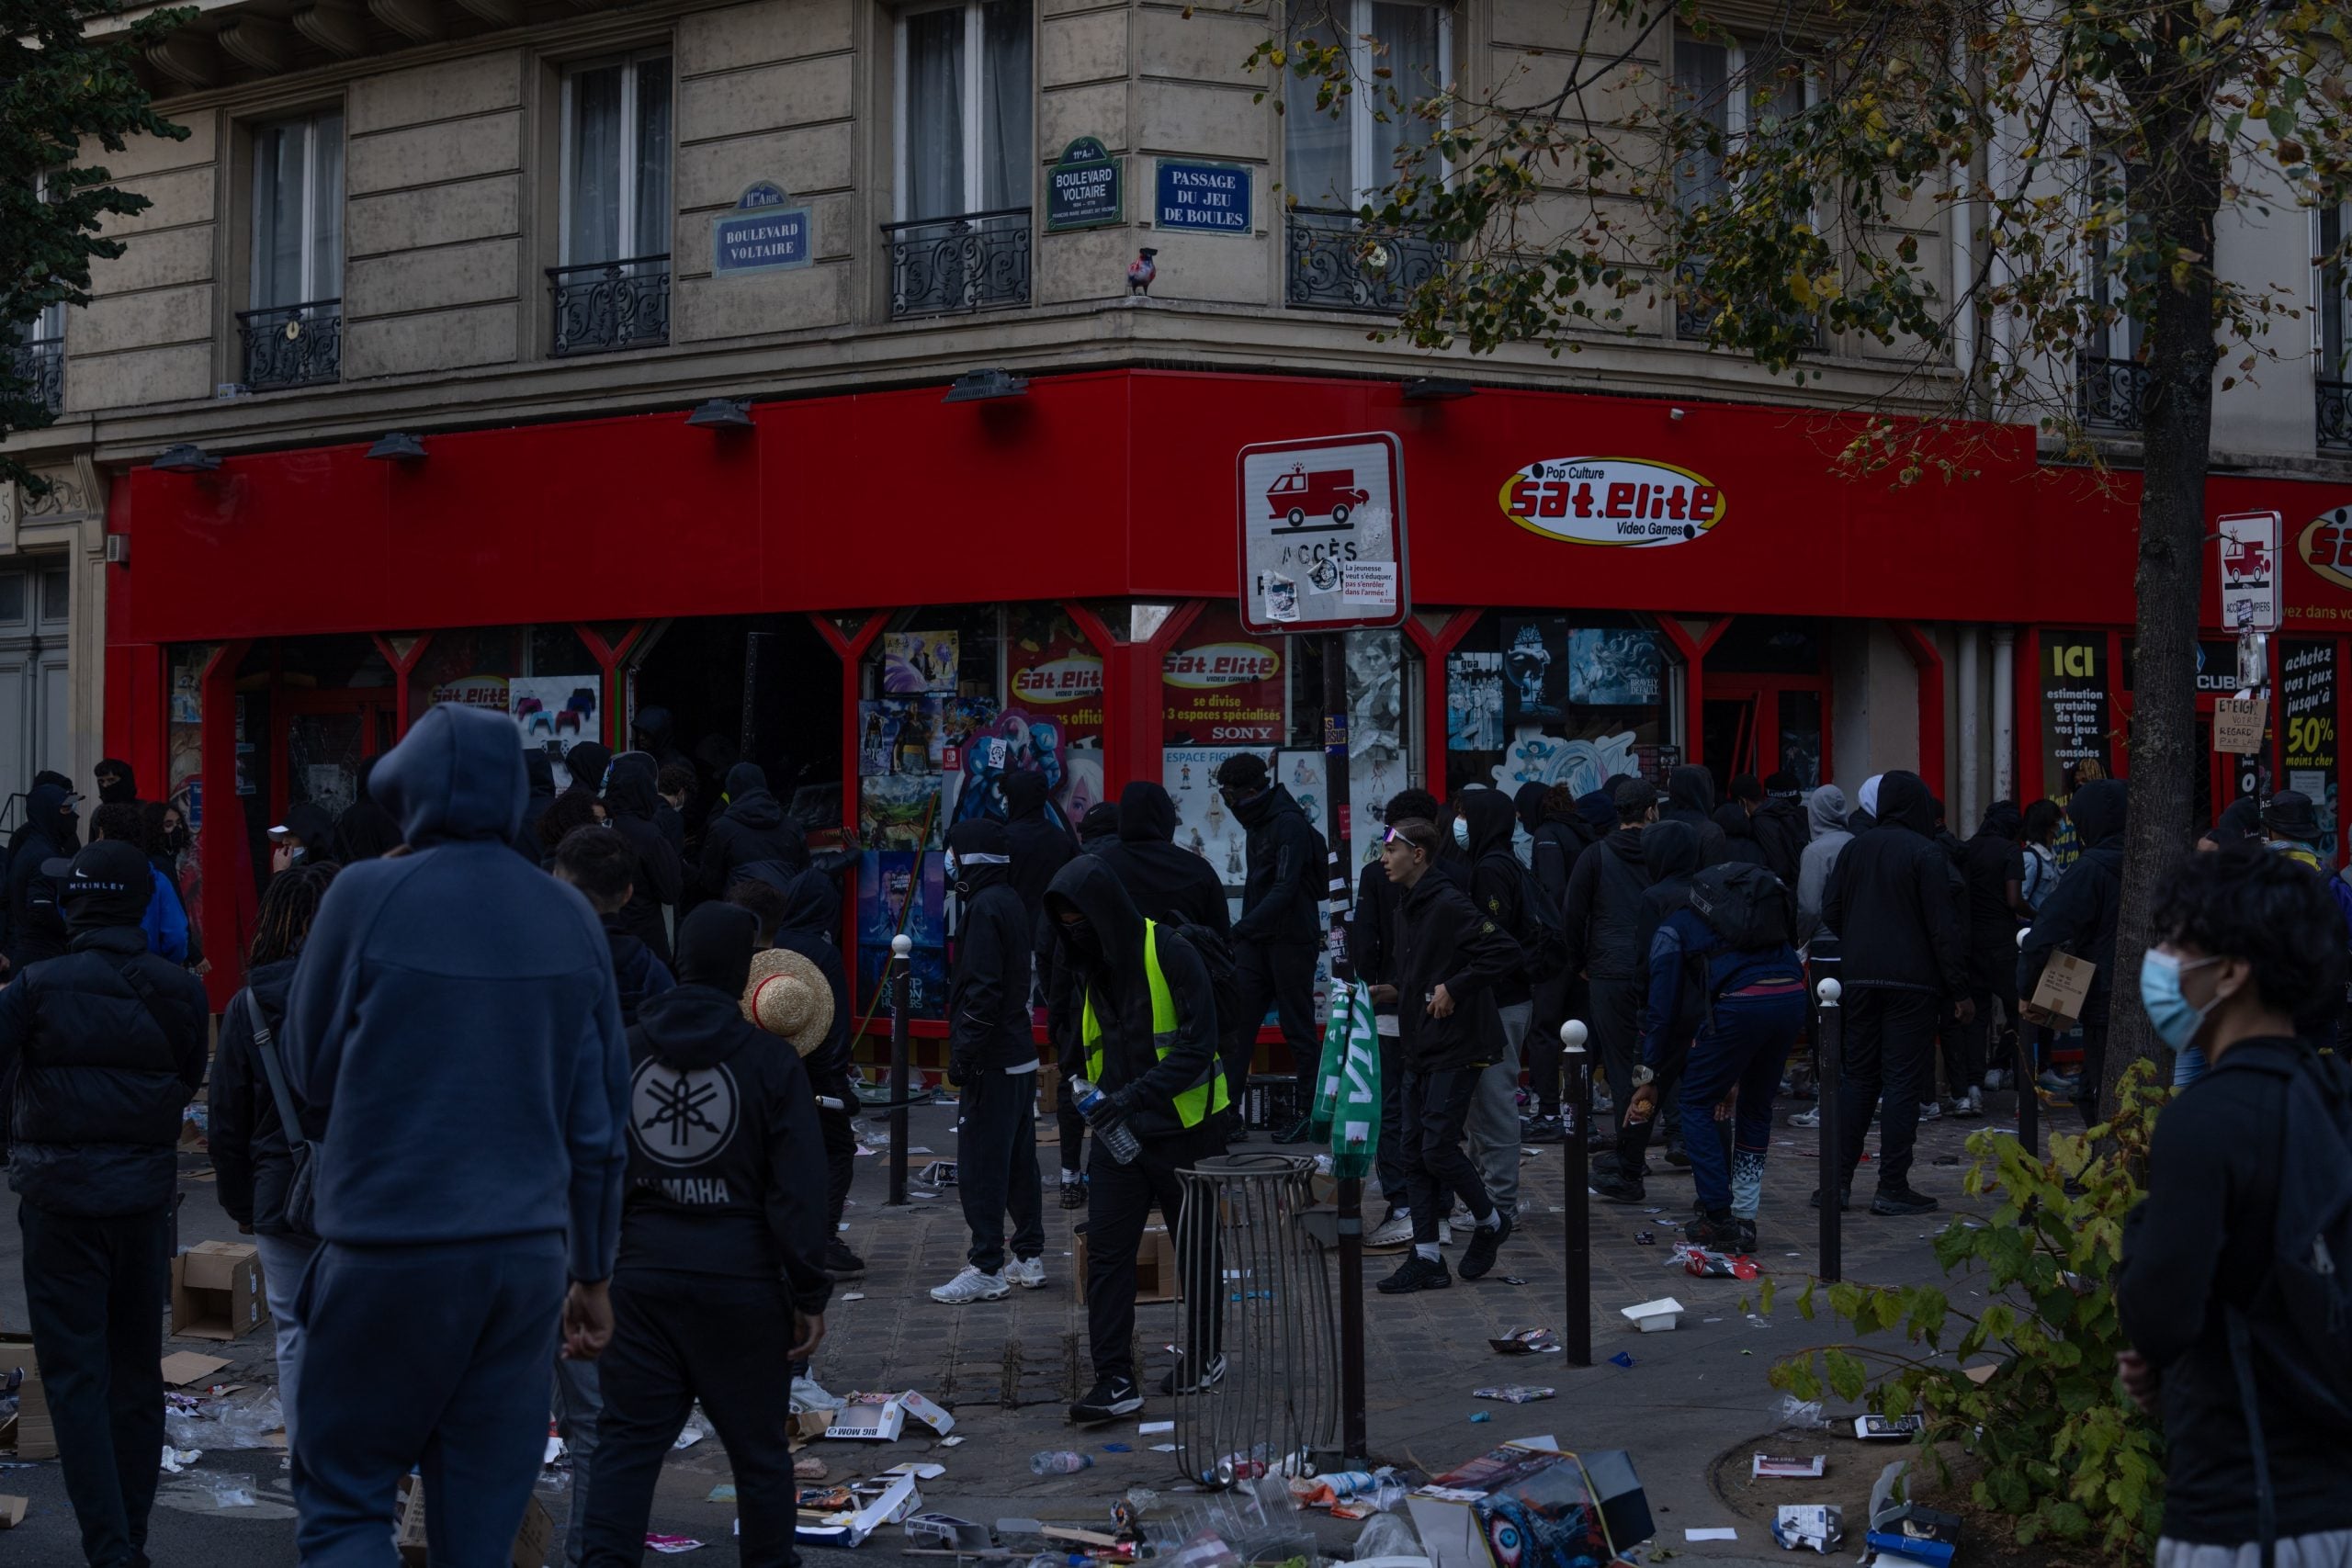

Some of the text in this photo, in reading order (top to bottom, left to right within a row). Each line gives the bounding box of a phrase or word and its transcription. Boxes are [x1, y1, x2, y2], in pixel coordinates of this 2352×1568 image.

[1056, 168, 1113, 188] BOULEVARD
[1171, 171, 1236, 189] PASSAGE
[1063, 184, 1106, 201] VOLTAIRE
[1177, 189, 1231, 207] DU JEU
[1164, 208, 1244, 226] DE BOULES
[726, 223, 798, 244] BOULEVARD
[730, 242, 794, 260] VOLTAIRE
[1546, 467, 1605, 481] Pop Culture
[1617, 522, 1683, 536] Video Games
[1361, 572, 1393, 581] s'éduquer,
[1362, 588, 1385, 596] l'armée
[2306, 604, 2337, 619] dans
[2052, 645, 2095, 677] ICI
[2285, 646, 2332, 672] achetez
[1017, 671, 1102, 691] sat.elit
[1631, 678, 1659, 686] BRAVELY
[2284, 669, 2333, 694] vos jeux
[1631, 686, 1658, 695] DEFAULT
[2046, 688, 2103, 700] estimation
[1193, 694, 1241, 706] se divise
[2053, 700, 2098, 713] gratuite
[2287, 686, 2331, 717] jusqu'à
[1168, 708, 1176, 719] 3
[1178, 711, 1220, 722] espaces
[1223, 708, 1281, 722] spécialisés
[2056, 711, 2096, 723] de tous
[1212, 727, 1273, 739] SONY
[2054, 722, 2098, 737] vos jeux
[2287, 716, 2335, 753] 50%
[2071, 735, 2083, 746] et
[1166, 751, 1206, 762] ESPACE
[2054, 747, 2100, 758] consoles
[2286, 752, 2335, 767] moins cher
[69, 882, 125, 891] McKINLEY
[636, 1177, 730, 1205] MAHA
[838, 1427, 878, 1436] BIG MOM
